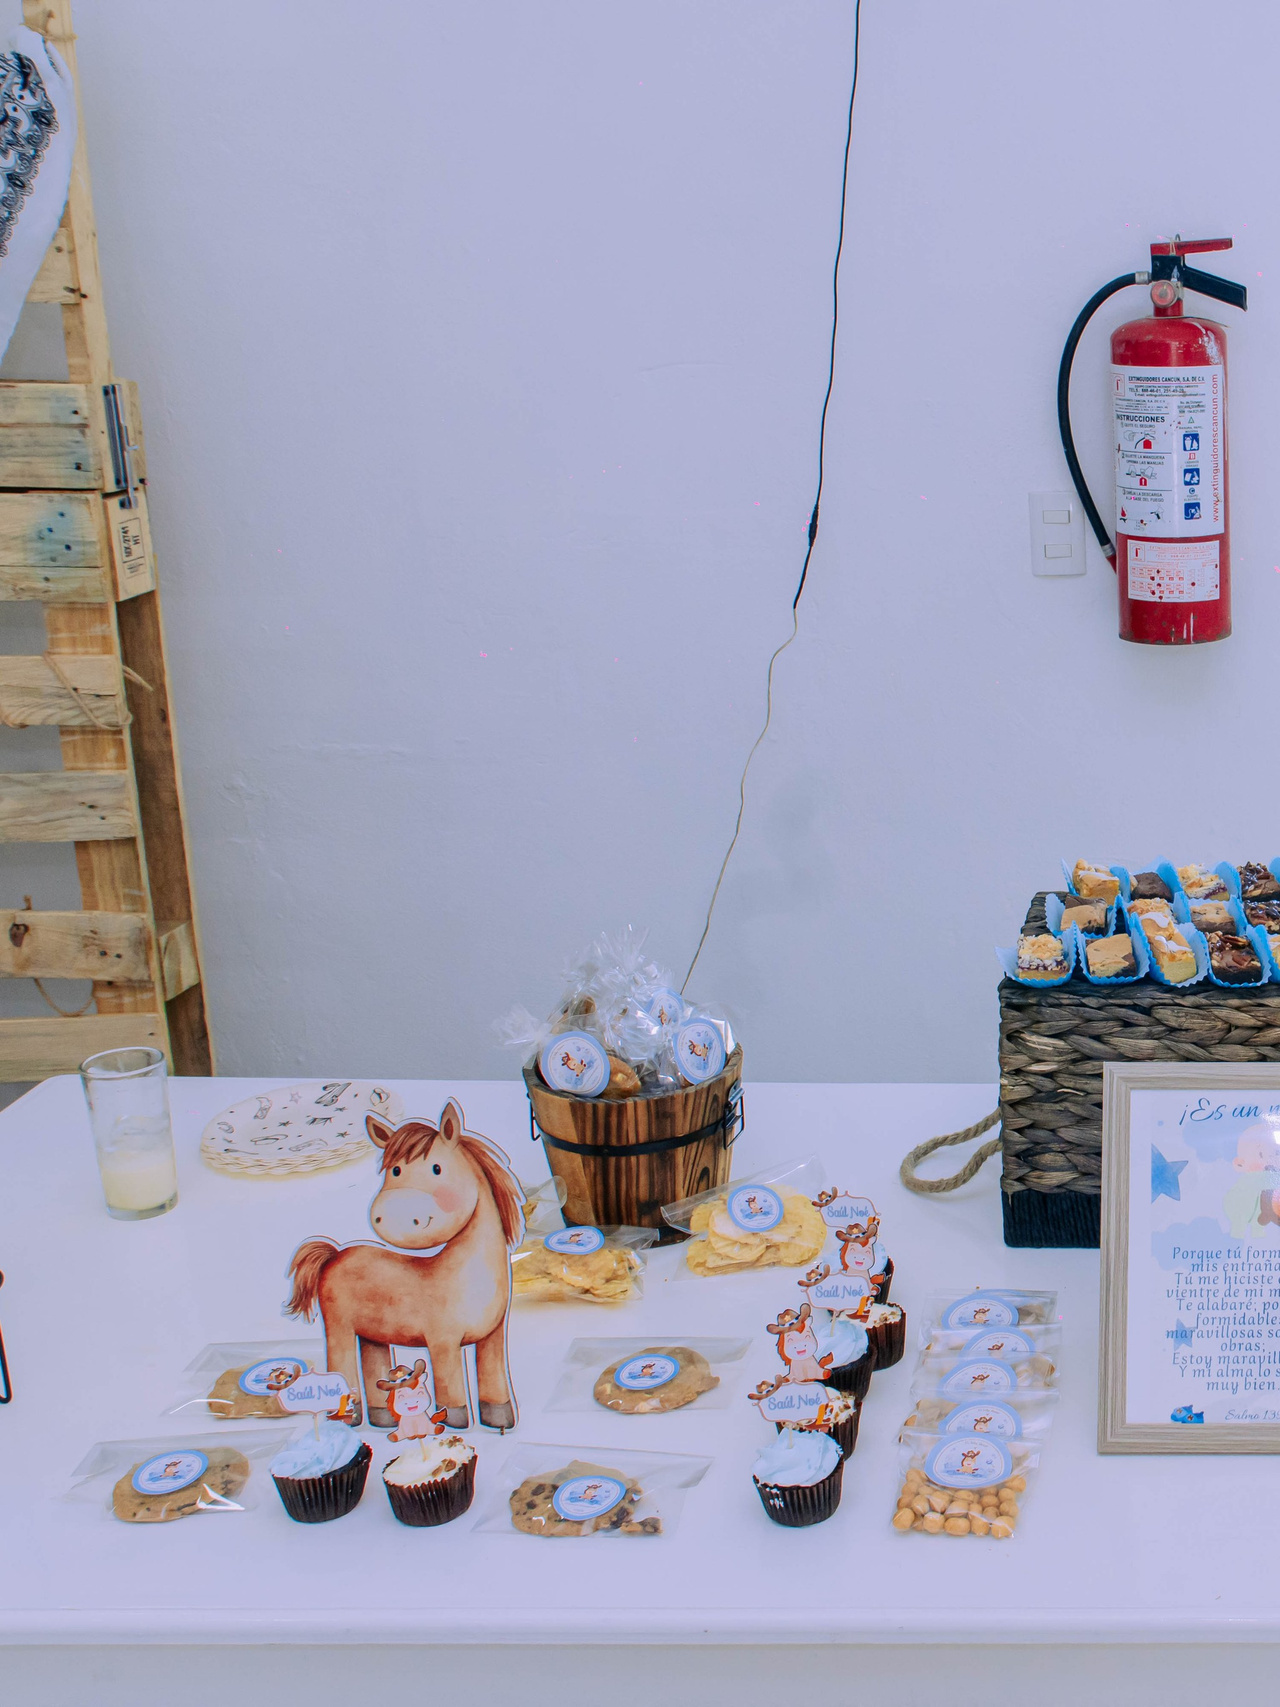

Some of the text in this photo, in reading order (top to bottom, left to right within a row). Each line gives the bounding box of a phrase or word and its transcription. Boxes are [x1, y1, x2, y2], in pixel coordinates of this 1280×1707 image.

[1116, 413, 1165, 423] INSTRUCCIONES
[1211, 373, 1220, 522] www.extinguidorescancun.com
[1179, 1097, 1225, 1125] ¡Es
[1232, 1104, 1261, 1118] un
[827, 1204, 870, 1218] Saúl Noé
[1172, 1247, 1222, 1263] Porque
[1227, 1247, 1241, 1259] tú
[1191, 1260, 1218, 1272] mis
[1175, 1272, 1193, 1285] Tú
[1198, 1275, 1219, 1285] me
[1224, 1271, 1273, 1285] hiciste
[815, 1284, 864, 1299] Saúl Noé
[1166, 1286, 1220, 1299] vientre
[1224, 1285, 1239, 1298] de
[1244, 1286, 1264, 1298] mi
[1177, 1298, 1193, 1311] Te
[1166, 1324, 1263, 1339] maravillosas
[1220, 1339, 1266, 1353] obras;
[1172, 1351, 1212, 1368] Estoy
[1179, 1366, 1187, 1378] Y
[1192, 1366, 1212, 1378] mi
[1216, 1364, 1253, 1378] alma
[1258, 1364, 1271, 1378] lo
[287, 1382, 343, 1401] Saúl Noé
[1206, 1379, 1280, 1395] muy bien.
[767, 1392, 822, 1411] Saúl Noé
[1225, 1409, 1260, 1420] Salmo
